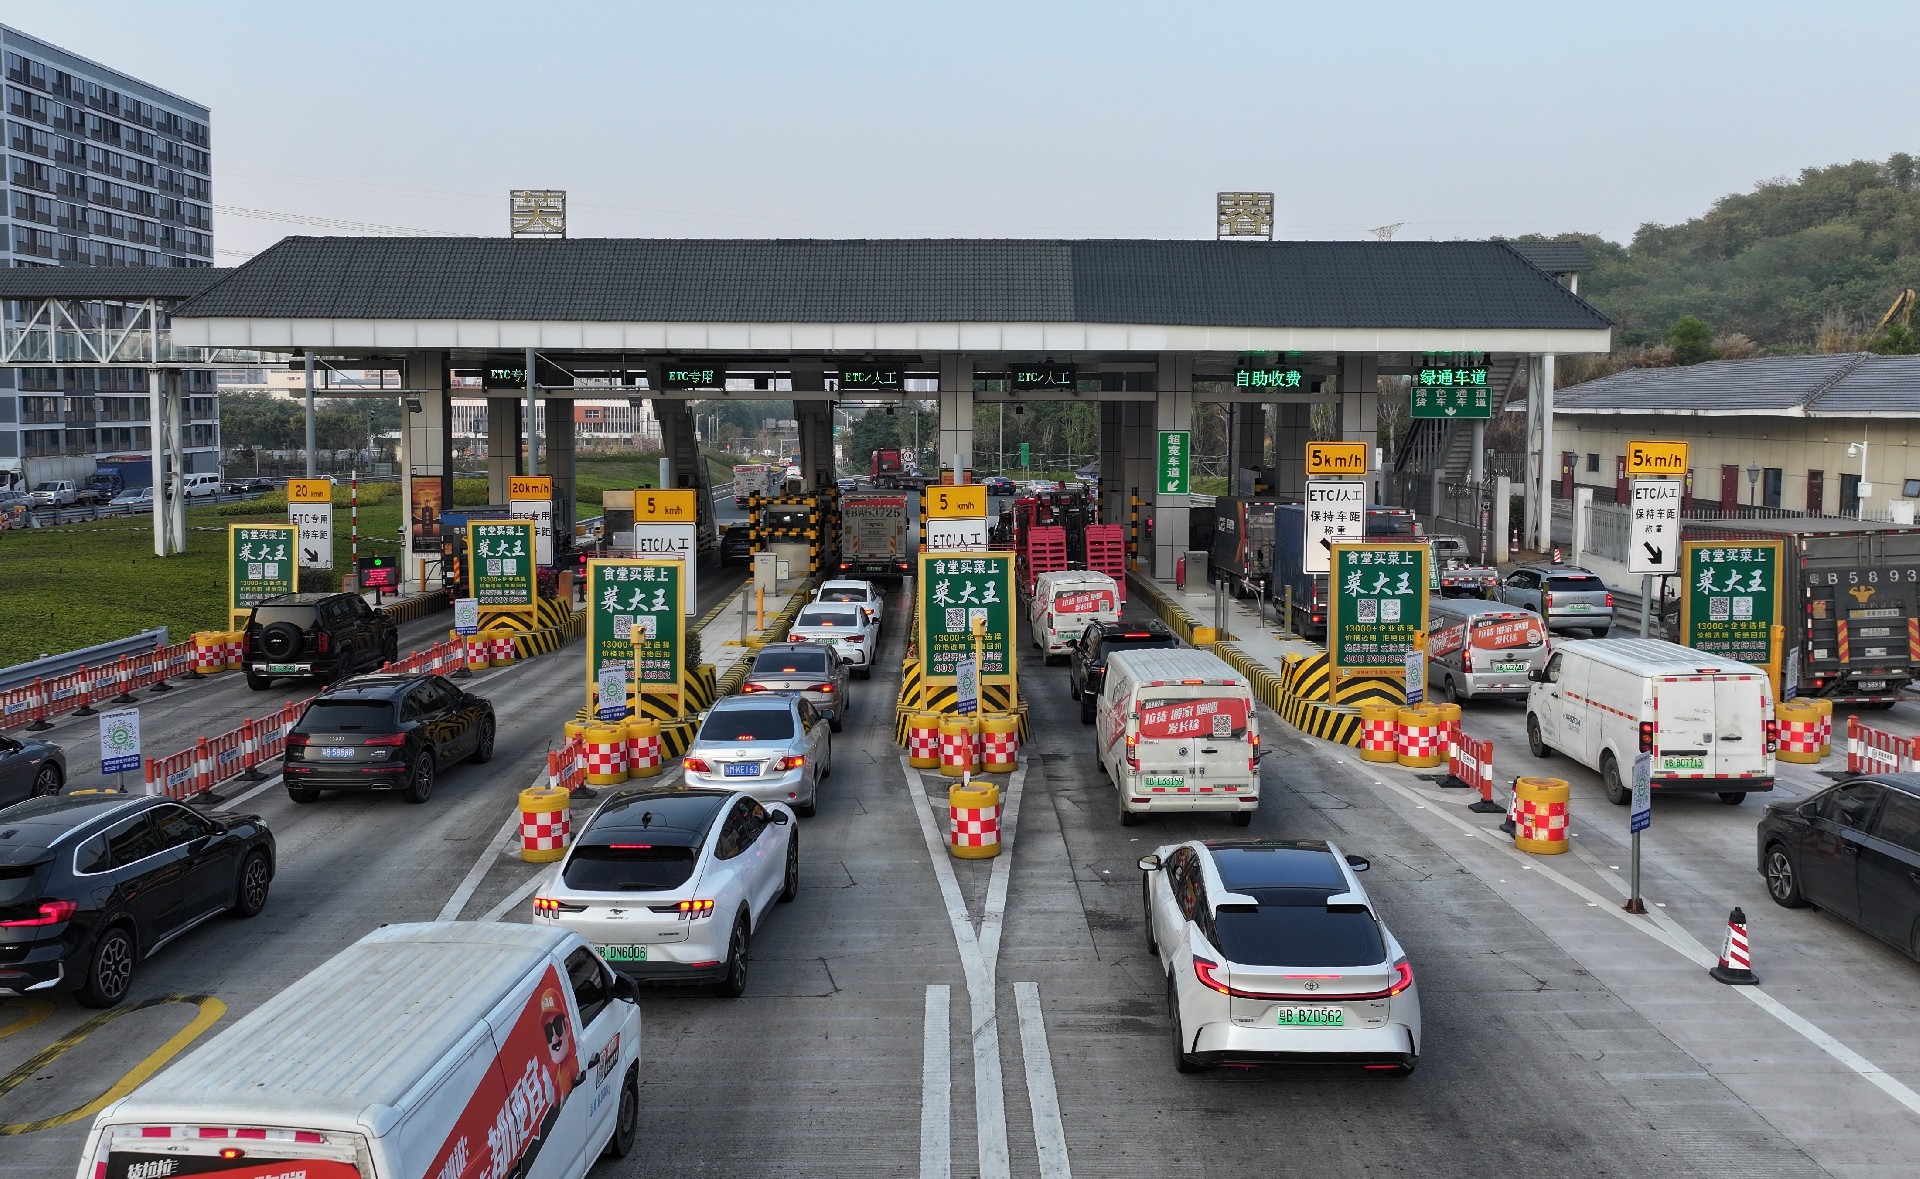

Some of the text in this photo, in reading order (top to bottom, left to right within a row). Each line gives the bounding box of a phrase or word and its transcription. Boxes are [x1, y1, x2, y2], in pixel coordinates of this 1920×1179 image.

[510, 191, 565, 232] 芙
[1218, 192, 1273, 235] 蓉
[669, 370, 713, 383] ETC专用
[1236, 370, 1301, 387] 自助收费
[1420, 369, 1487, 386] 绿通车道
[1416, 389, 1487, 397] 绿色通道
[1416, 398, 1487, 407] 货车车道
[1167, 434, 1180, 478] 超宽车道
[1312, 449, 1362, 468] 5km/h
[1633, 449, 1682, 468] 5km/h
[296, 485, 308, 497] 20
[512, 483, 549, 494] 20km/h
[1636, 486, 1677, 500] ETC/人工
[940, 494, 974, 510] 5 km/h
[1310, 490, 1362, 502] ETC/人工
[647, 497, 683, 515] 5 km/h
[292, 514, 328, 524] ETC专用
[1311, 511, 1361, 522] 保持车距
[1636, 509, 1676, 520] 保持车距
[240, 530, 288, 540] 食堂买菜上
[299, 530, 328, 540] 持车距
[478, 526, 524, 536] 食堂买菜上
[1324, 526, 1346, 535] 称重
[641, 538, 689, 552] ETC/人工
[933, 533, 981, 548] ETC/人工
[239, 542, 288, 562] 菜大王
[478, 539, 526, 558] 菜大王
[1347, 551, 1414, 565] 食堂买菜上
[1699, 549, 1766, 563] 食堂买菜上
[934, 560, 1000, 574] 食堂买菜上
[603, 567, 669, 582] 食堂买菜上
[1696, 568, 1767, 595] 菜大王
[1344, 570, 1414, 597] 菜大王
[601, 586, 670, 614] 菜大王
[933, 579, 1000, 608] 菜大王
[934, 633, 1002, 641] 13000+企选择
[934, 664, 954, 672] 400
